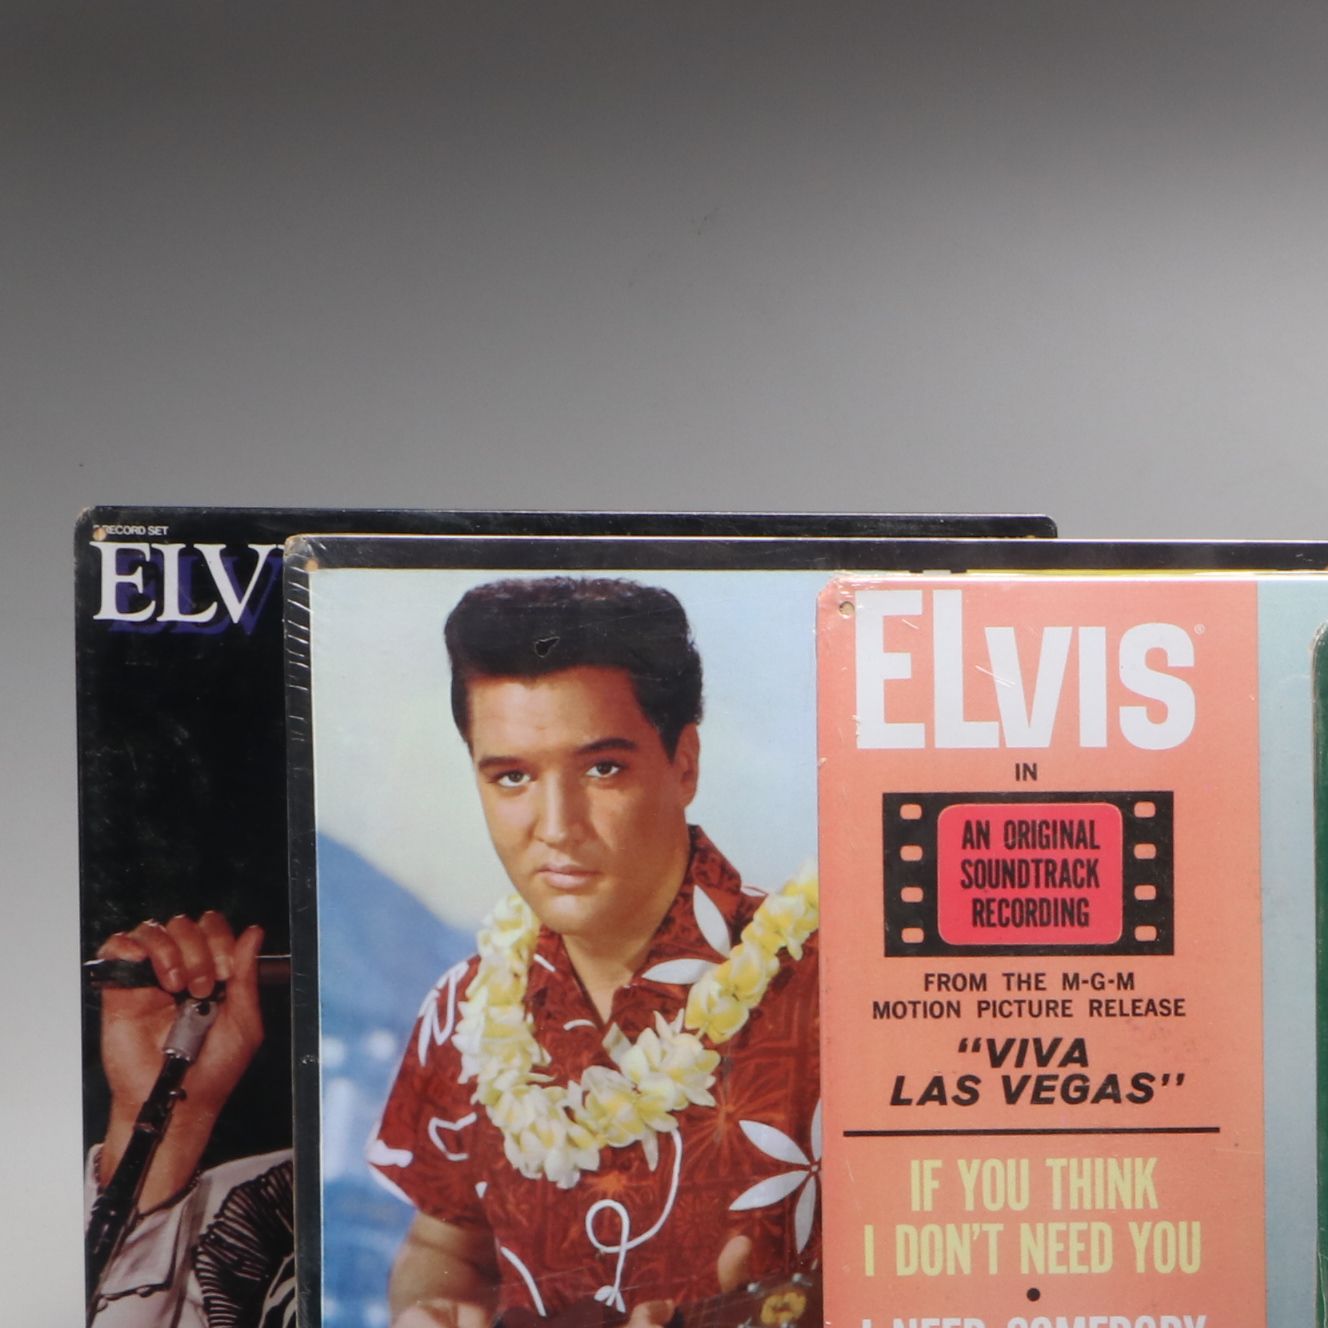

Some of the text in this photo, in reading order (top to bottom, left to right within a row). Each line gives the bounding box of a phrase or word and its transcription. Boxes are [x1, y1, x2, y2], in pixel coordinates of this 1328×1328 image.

[147, 525, 169, 535] SET
[90, 541, 284, 624] ELV
[855, 589, 1196, 750] ELVIS
[1014, 763, 1038, 782] IN
[961, 819, 1101, 850] AN ORIGINAL
[960, 858, 1100, 890] SOUNDTRACK
[972, 897, 1090, 928] RECORDING
[923, 972, 1136, 993] FROM THE M-G-M
[872, 998, 1186, 1020] MOTION PICTURE RELEASE
[889, 1074, 982, 1107] LAS
[910, 1157, 1160, 1212] IF YOU THINK
[864, 1221, 1202, 1277] I DON'T NEED YOU
